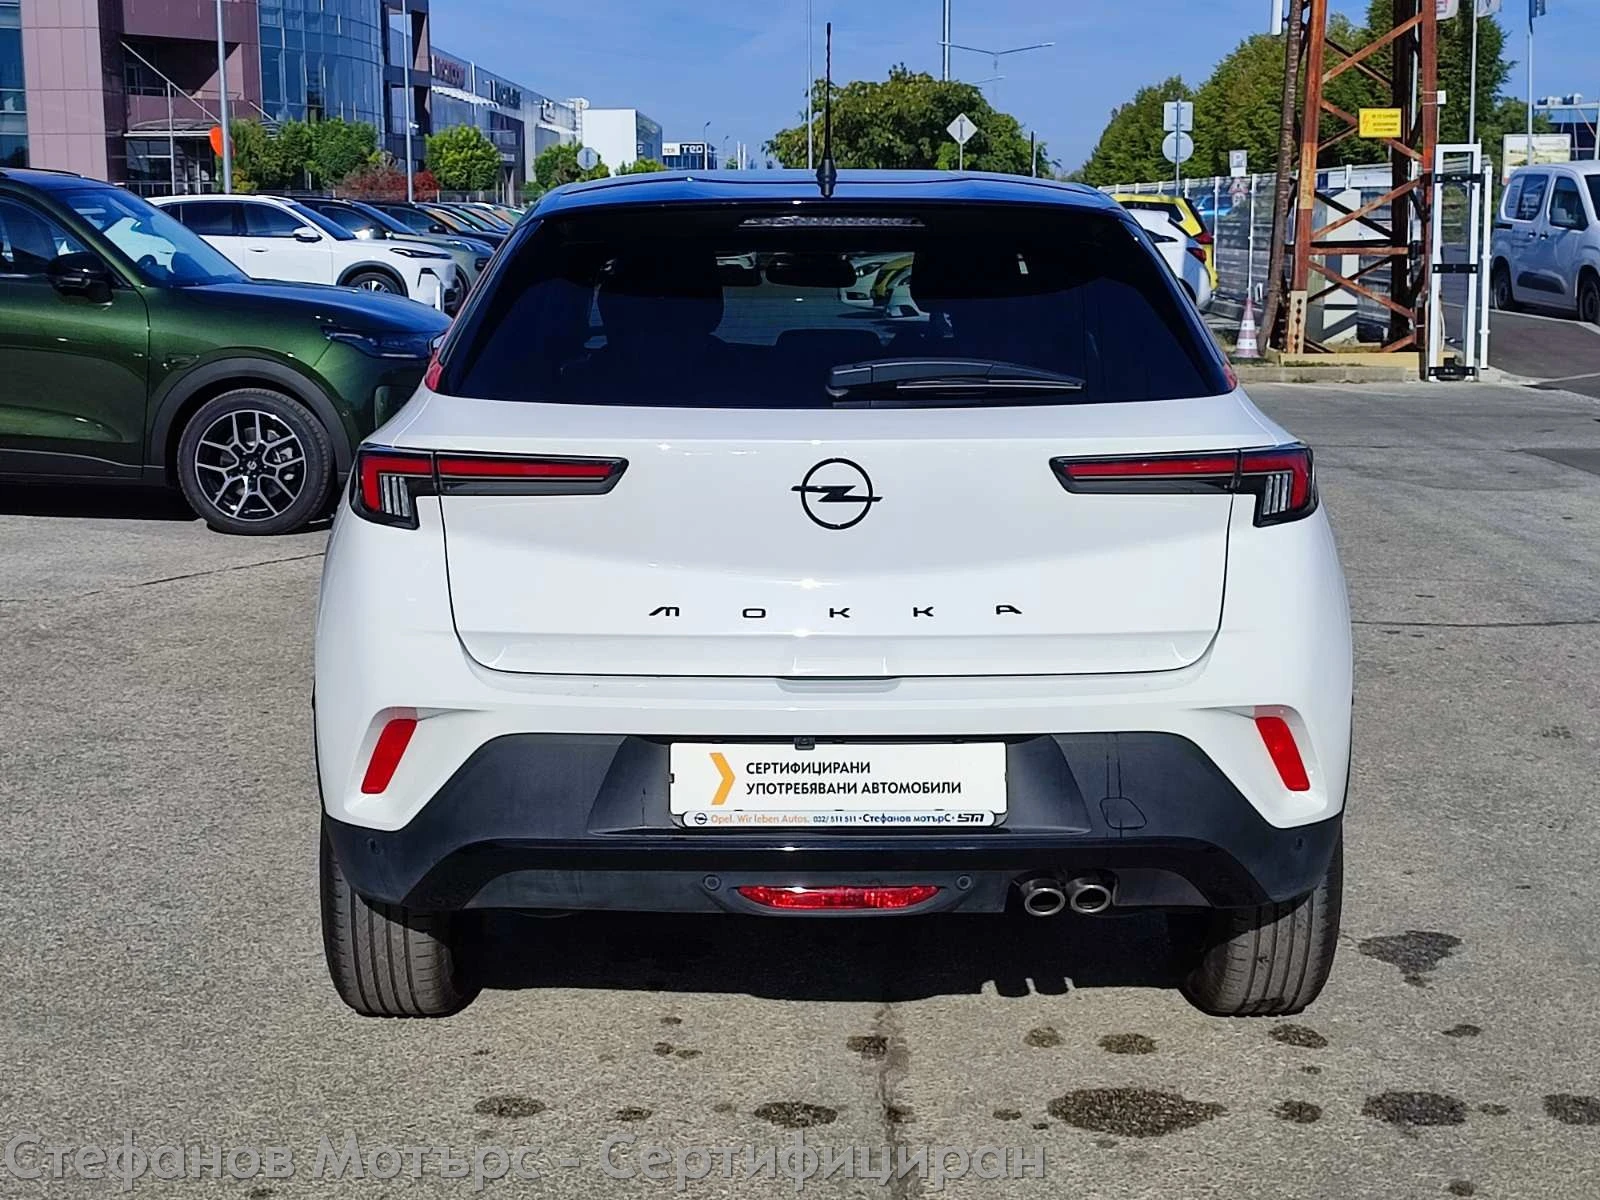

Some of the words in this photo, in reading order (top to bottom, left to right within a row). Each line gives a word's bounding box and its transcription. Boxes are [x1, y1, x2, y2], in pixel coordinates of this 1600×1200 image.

[648, 604, 1023, 619] MOKKA
[746, 761, 871, 777] СЕРТИФИЦИРАНИ
[746, 782, 858, 795] УПОТРЕБЯВАНИ
[861, 781, 962, 795] АВТОМОБИЛИ
